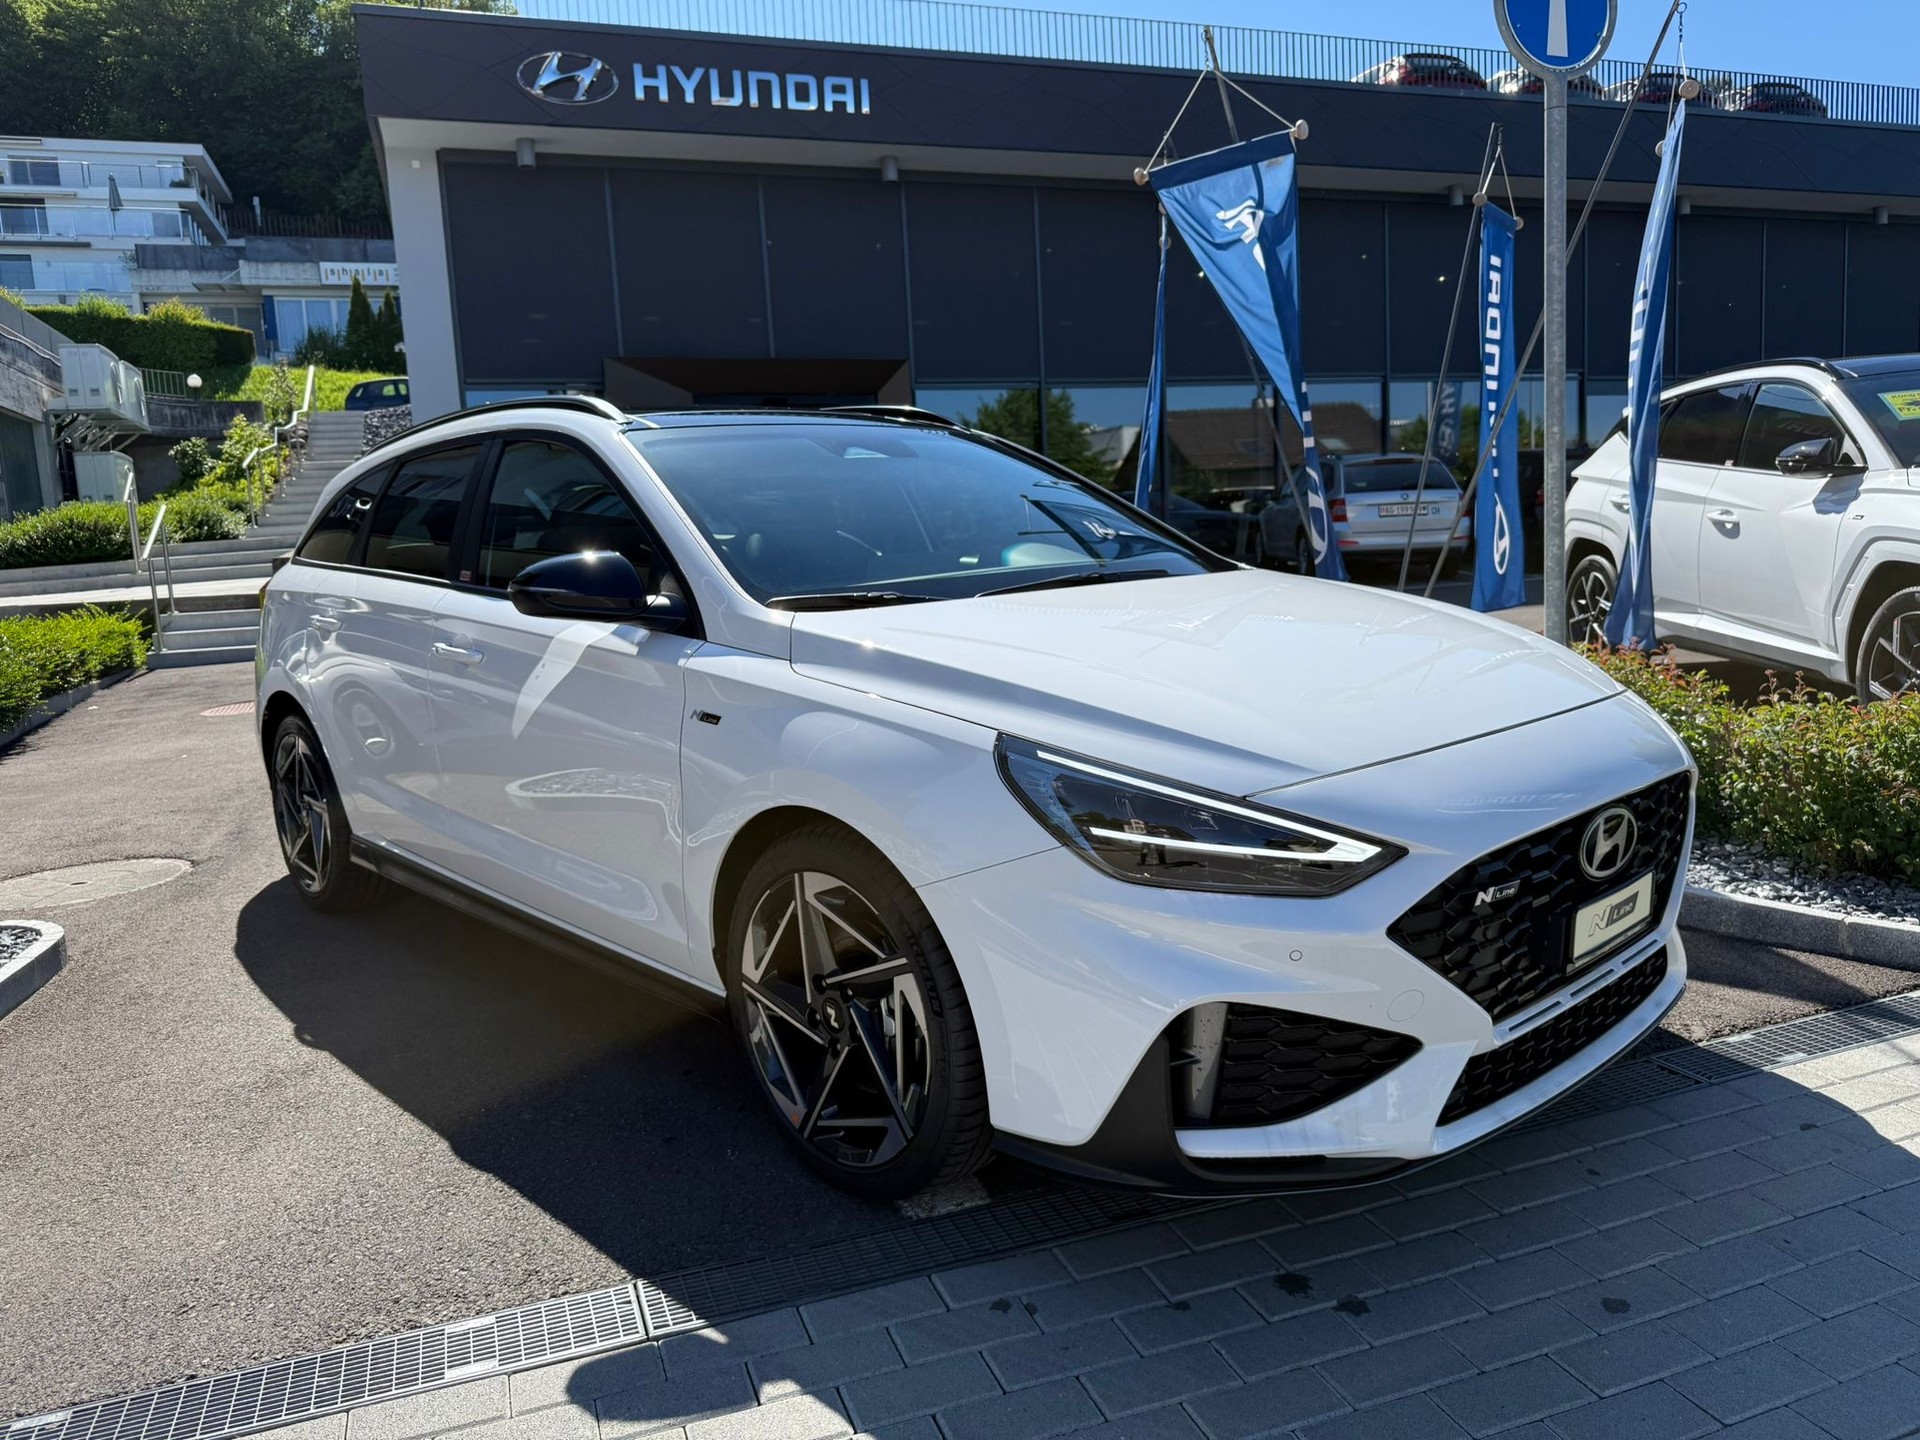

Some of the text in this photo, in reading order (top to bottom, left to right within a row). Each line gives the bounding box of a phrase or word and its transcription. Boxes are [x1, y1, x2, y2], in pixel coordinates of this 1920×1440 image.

[632, 62, 870, 115] HYUNDAI
[1475, 886, 1515, 906] N Line
[1588, 902, 1633, 938] N Line
